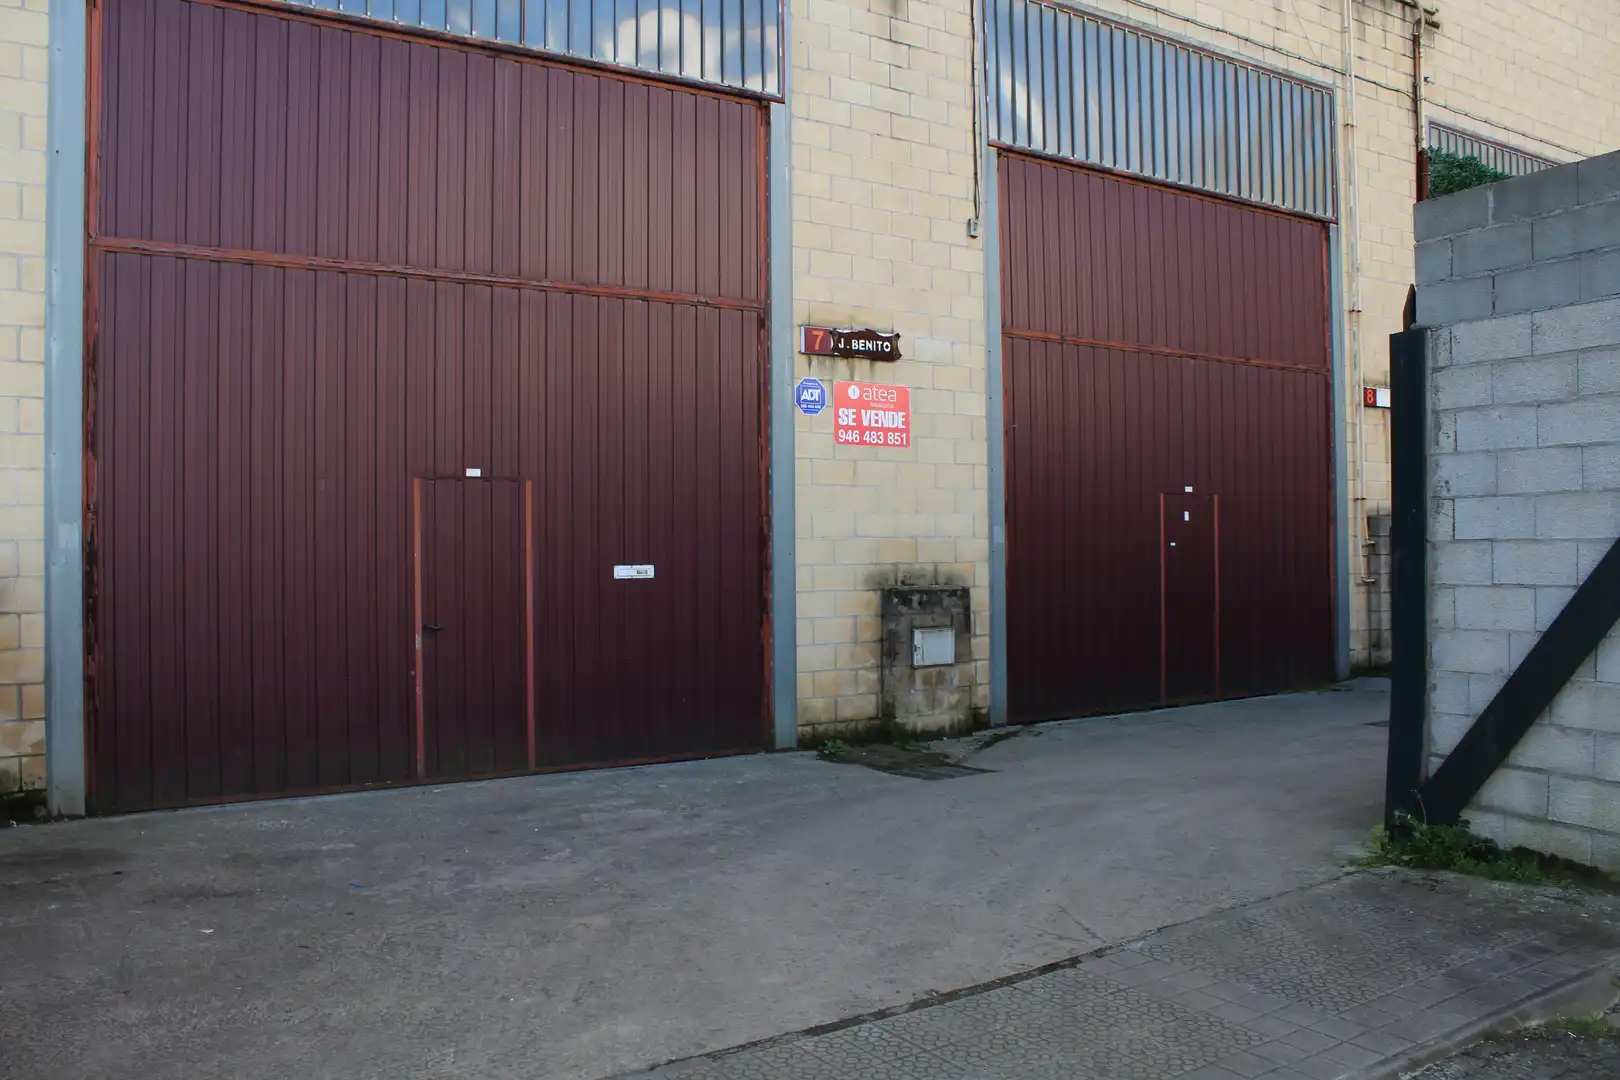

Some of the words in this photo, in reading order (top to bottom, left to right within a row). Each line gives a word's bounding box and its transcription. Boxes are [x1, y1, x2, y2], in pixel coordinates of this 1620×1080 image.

[812, 330, 824, 350] 7
[852, 339, 891, 352] BENITO
[801, 388, 821, 401] ADT
[863, 385, 897, 402] atea
[1367, 389, 1374, 404] 8
[838, 408, 857, 426] SE
[861, 409, 906, 428] VENDE
[838, 429, 860, 443] 946
[863, 430, 884, 444] 483
[887, 432, 907, 445] 851
